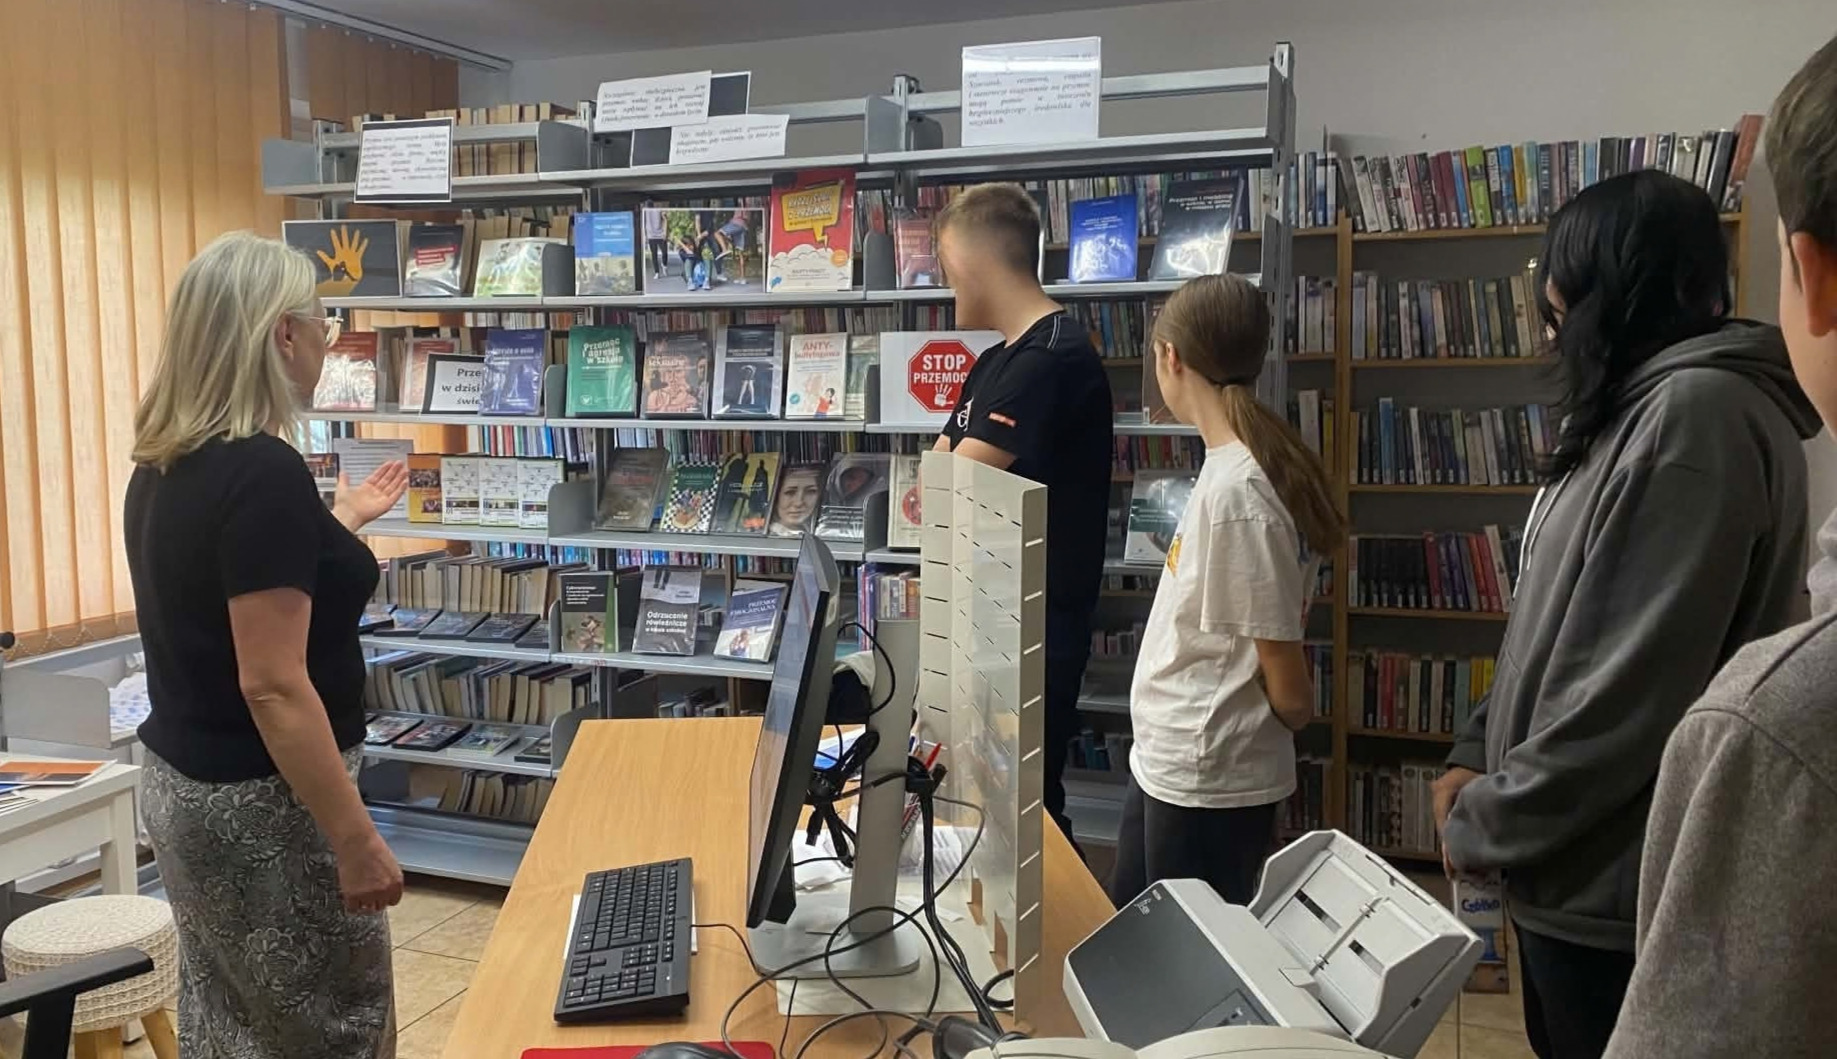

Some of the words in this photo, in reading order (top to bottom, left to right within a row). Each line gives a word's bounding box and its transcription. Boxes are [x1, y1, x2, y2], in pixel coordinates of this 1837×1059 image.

[584, 338, 620, 351] Przemoc
[923, 354, 967, 371] STOP
[457, 368, 482, 377] Prze
[914, 372, 968, 384] PRZEMOC
[455, 384, 480, 392] dzisi
[647, 611, 688, 620] Odrzucenie
